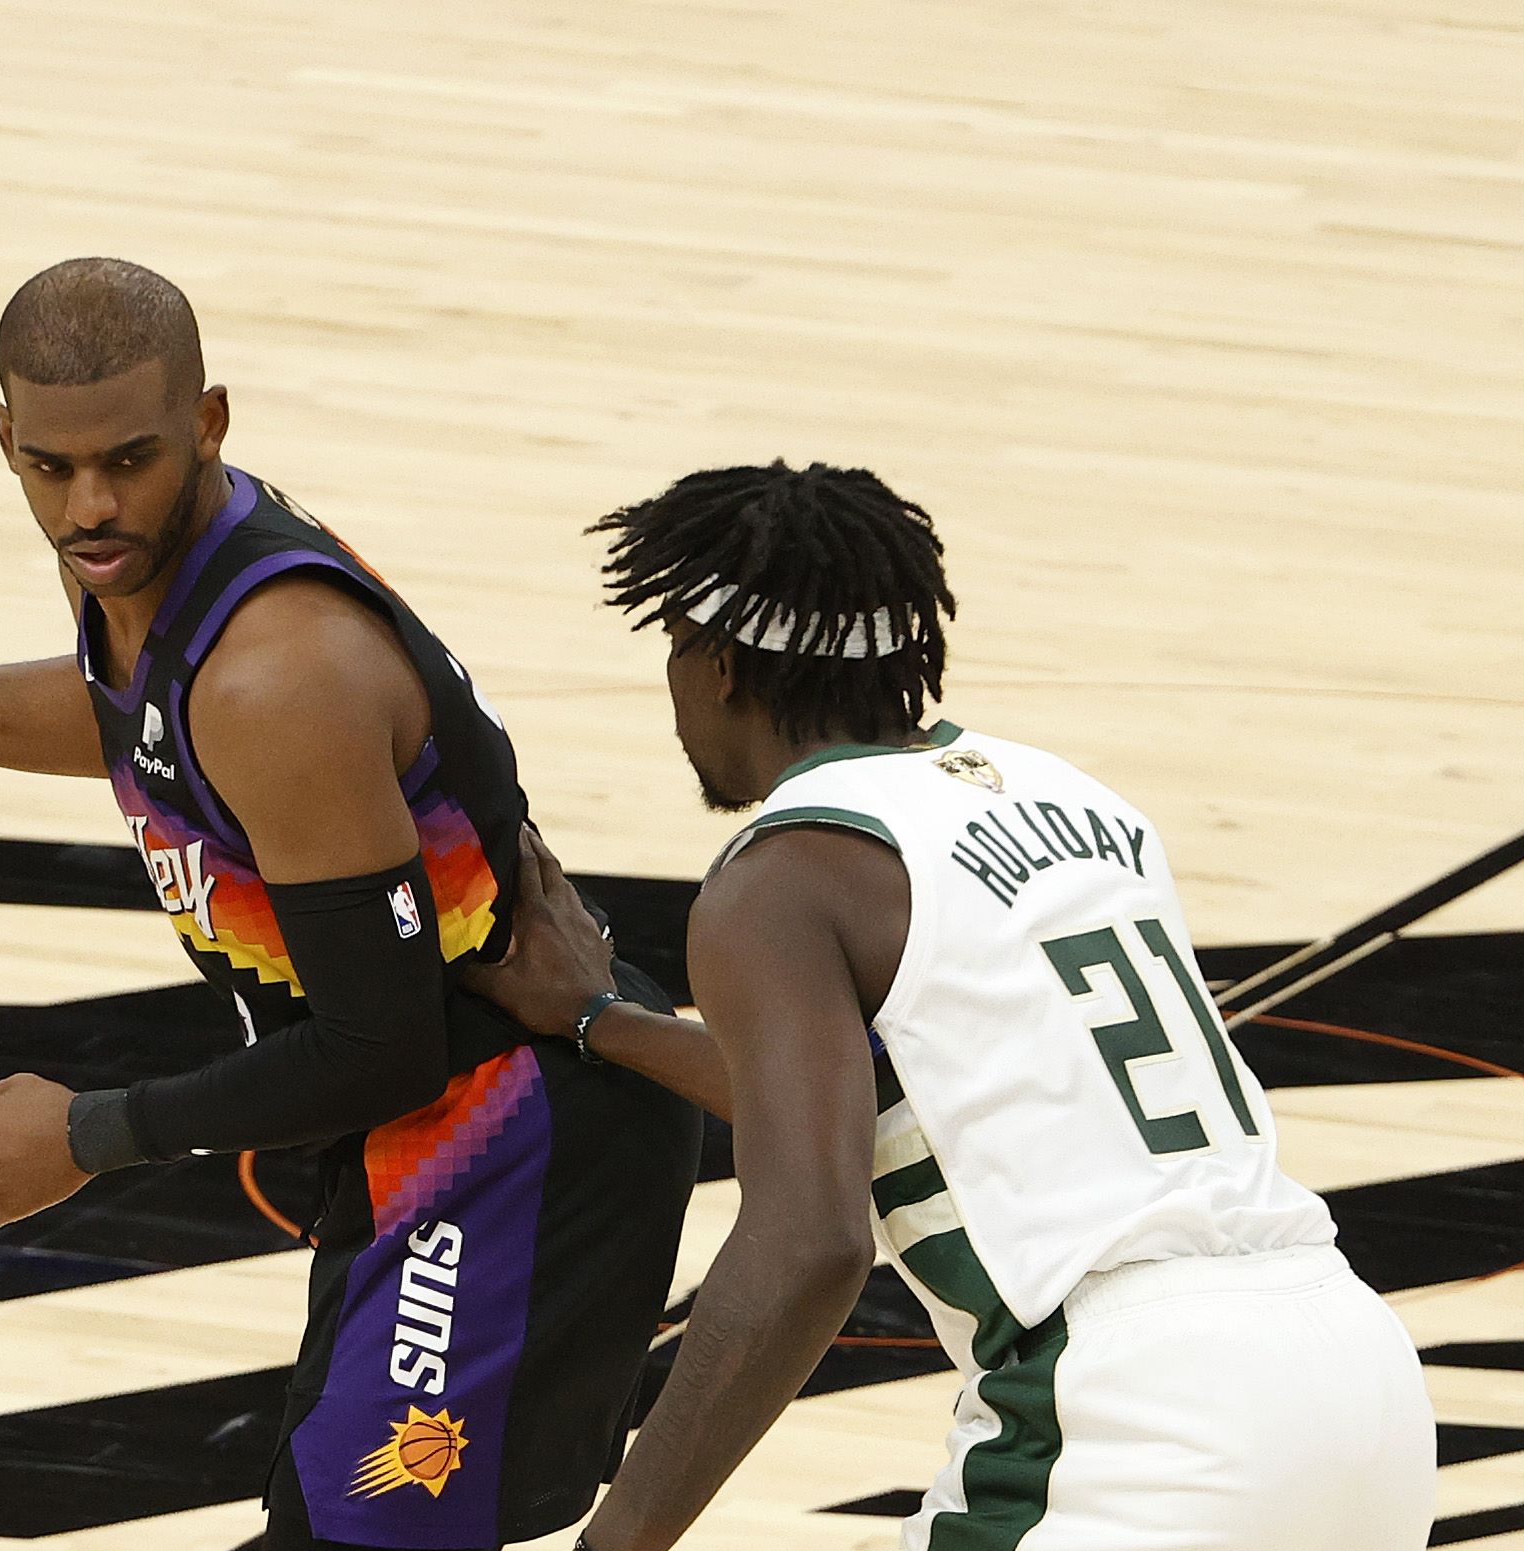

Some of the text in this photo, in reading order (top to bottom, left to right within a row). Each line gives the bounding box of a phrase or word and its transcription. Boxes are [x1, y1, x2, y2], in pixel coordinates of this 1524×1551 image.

[132, 746, 175, 781] PayPal
[950, 800, 1147, 909] HOLIDAY
[1036, 916, 1266, 1158] 21
[389, 1219, 464, 1396] SUNS
